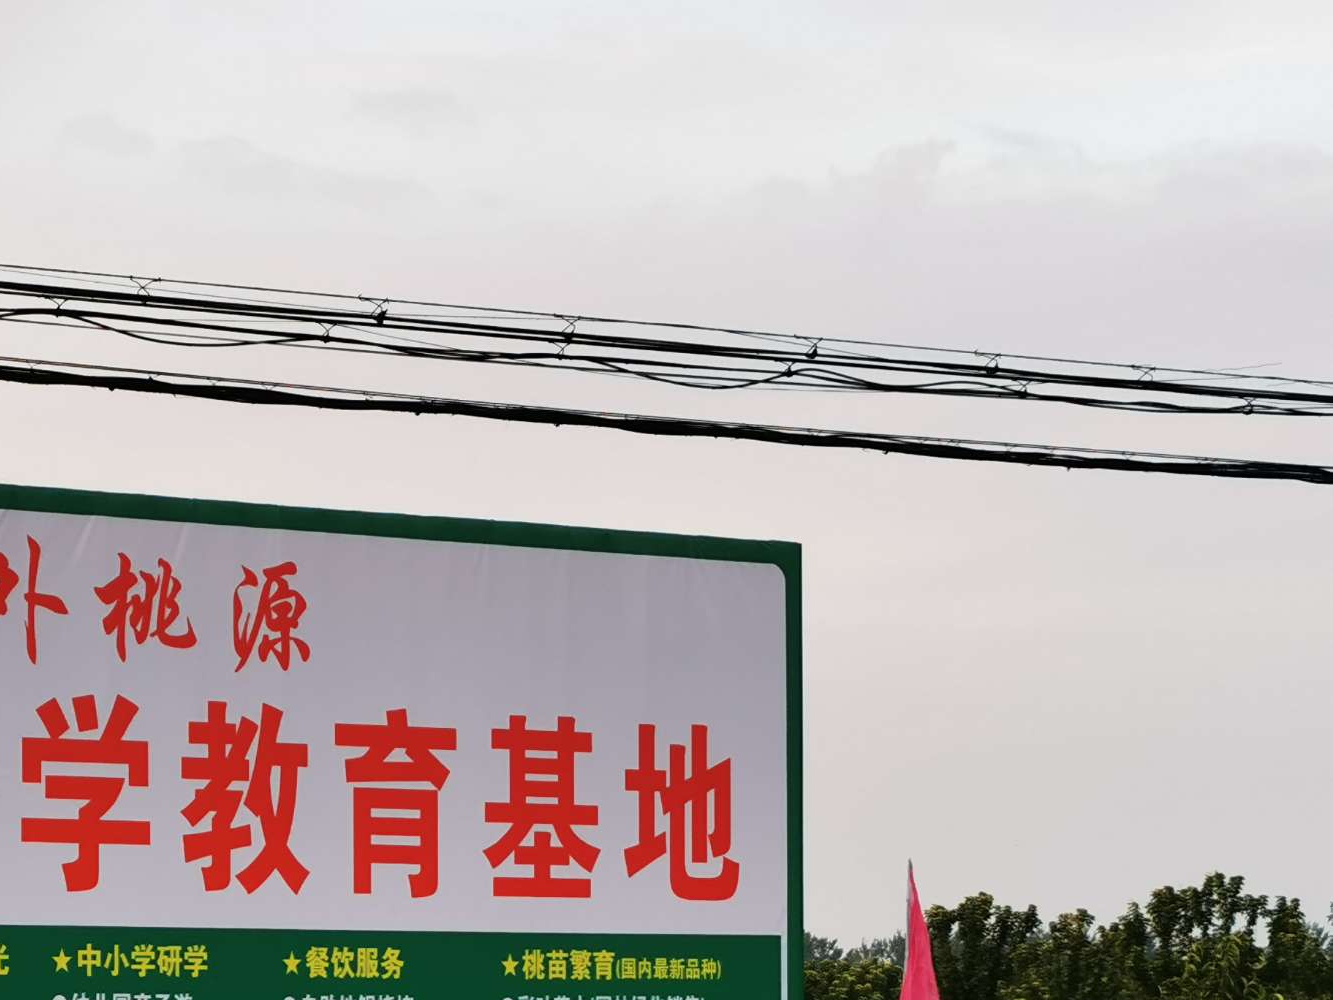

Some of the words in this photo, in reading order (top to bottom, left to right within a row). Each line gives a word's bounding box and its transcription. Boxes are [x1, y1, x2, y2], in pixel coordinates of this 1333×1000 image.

[77, 943, 208, 978] 中小学研学
[305, 946, 404, 980] 餐饮服务
